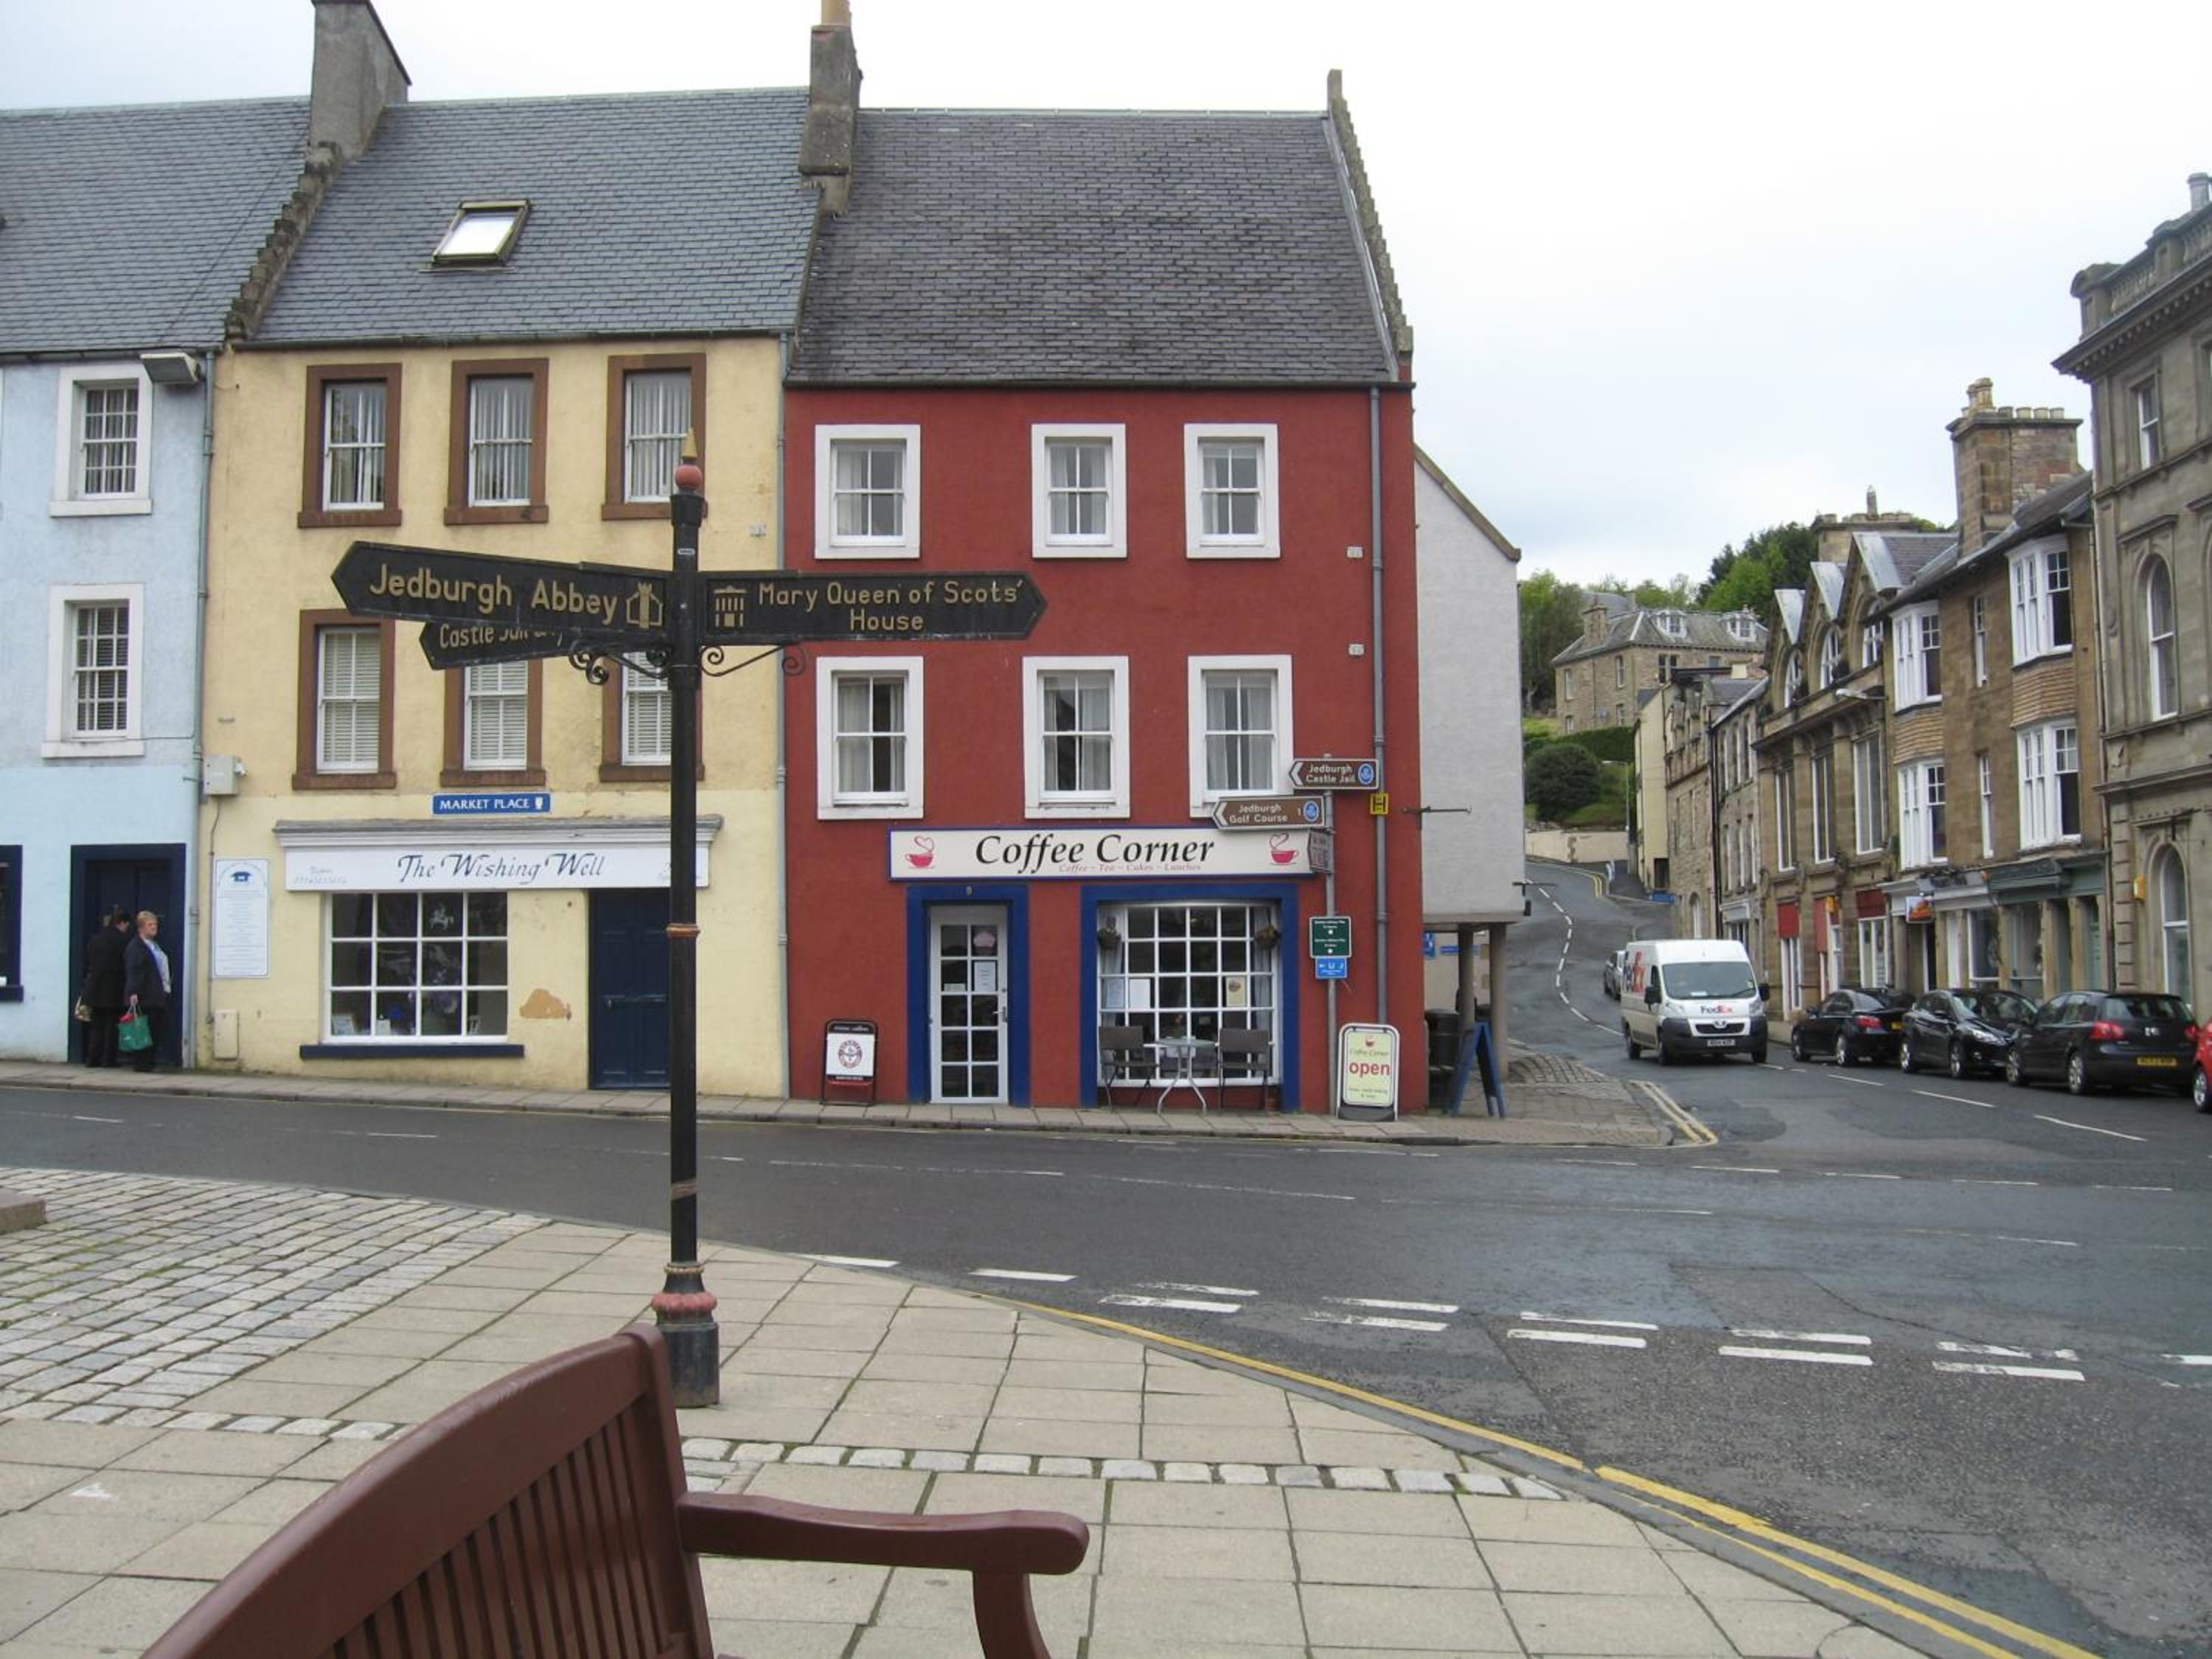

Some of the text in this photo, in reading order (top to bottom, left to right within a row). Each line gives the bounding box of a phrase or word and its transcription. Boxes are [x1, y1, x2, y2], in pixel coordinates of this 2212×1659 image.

[369, 564, 618, 624] Jedburgh Abbey
[759, 582, 818, 612] Mary
[827, 582, 900, 605] Queen
[908, 581, 934, 605] of
[849, 609, 924, 631] House
[440, 623, 495, 649] Castle
[1309, 764, 1353, 775] Jedburgh
[1306, 774, 1357, 784] Castle Jail
[439, 798, 530, 810] MARKET PLACE
[1238, 804, 1282, 814] Jedburgh
[1229, 814, 1288, 824] Golf Course
[975, 832, 1215, 874] Coffee Corner
[397, 852, 605, 885] The Wishing Well
[1700, 1005, 1734, 1015] FedEx
[1349, 1062, 1391, 1078] open
